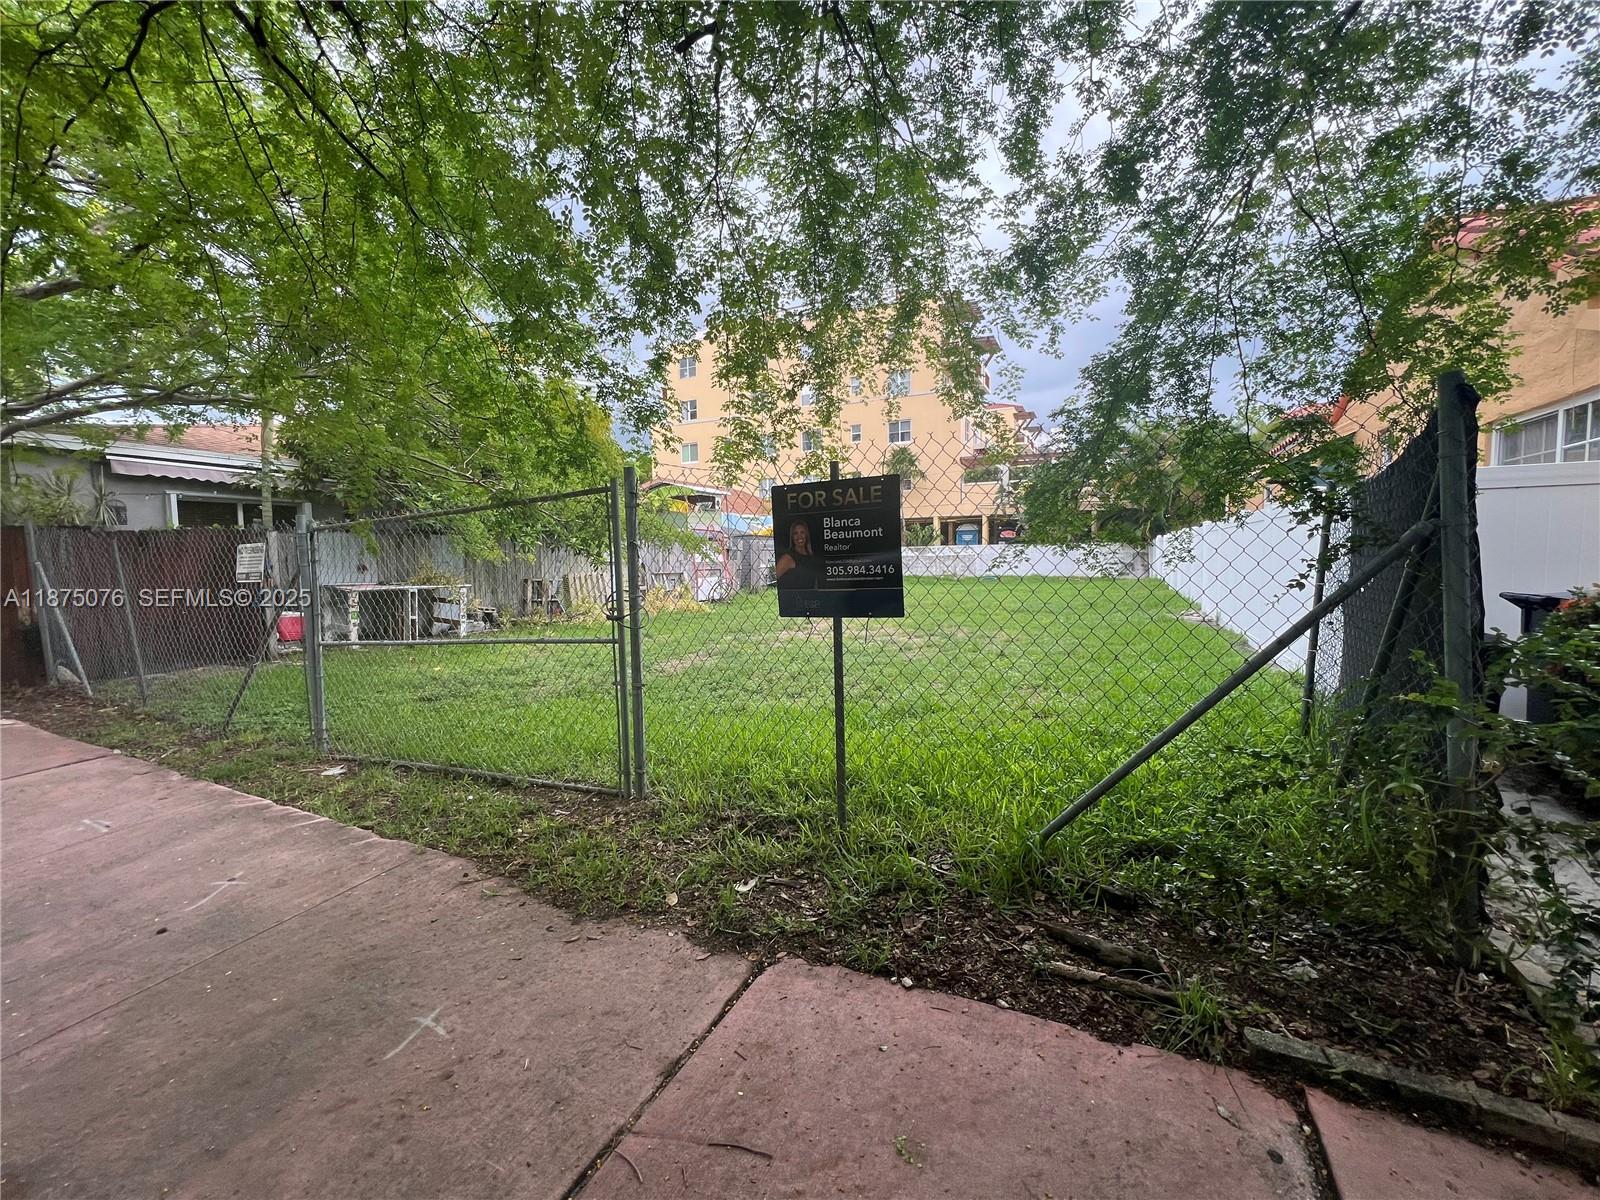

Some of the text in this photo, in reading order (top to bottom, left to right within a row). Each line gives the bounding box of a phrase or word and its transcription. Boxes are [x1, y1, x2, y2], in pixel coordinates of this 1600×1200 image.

[787, 485, 882, 510] FOR SALE
[823, 517, 861, 528] Blanca
[823, 527, 883, 540] Beaumont
[824, 543, 851, 552] Realtor
[826, 565, 895, 576] 305.984.3416
